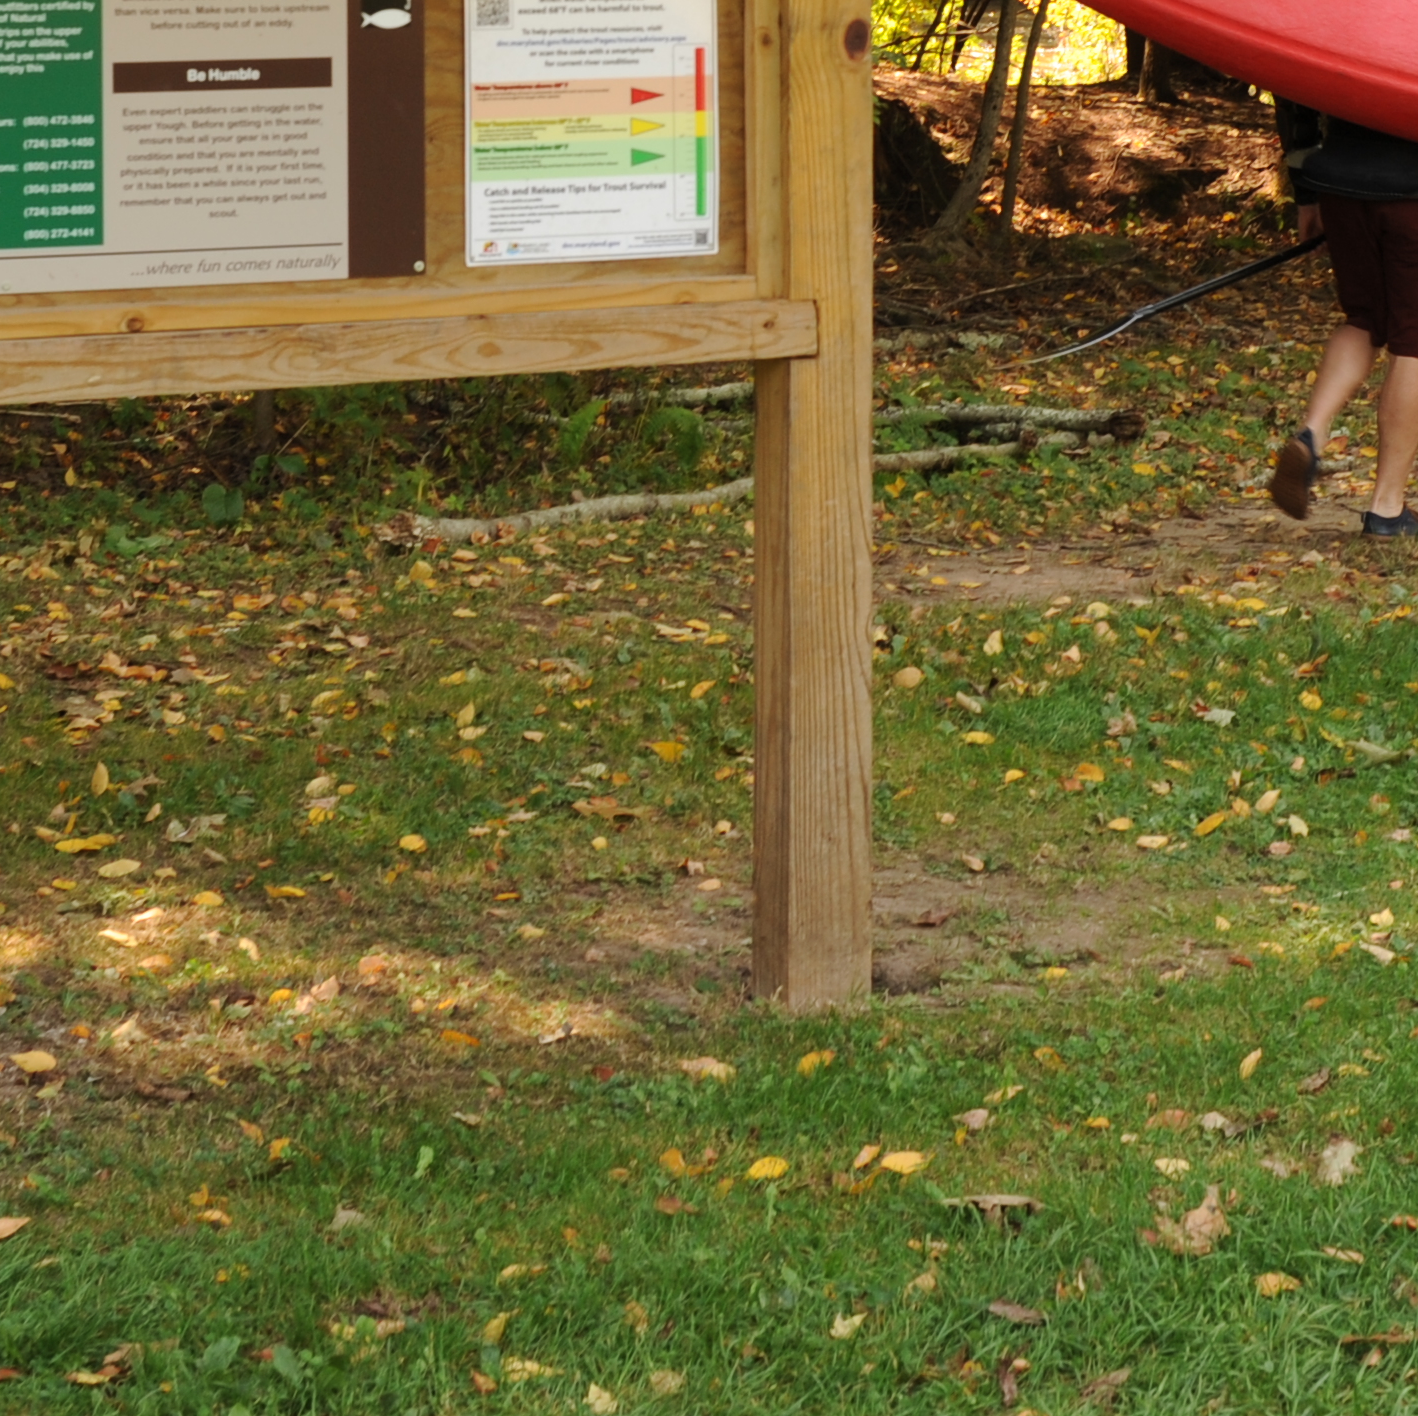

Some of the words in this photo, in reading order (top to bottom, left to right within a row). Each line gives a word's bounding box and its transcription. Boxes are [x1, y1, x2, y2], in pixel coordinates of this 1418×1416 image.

[186, 68, 206, 83] Be
[208, 67, 260, 82] Humble
[484, 188, 510, 197] Catch
[511, 187, 530, 196] and
[531, 186, 566, 195] Release
[568, 184, 586, 194] Tips
[588, 183, 603, 193] for
[603, 183, 627, 192] Trout
[629, 182, 667, 191] Survival
[130, 260, 193, 276] ...where
[197, 259, 221, 273] fun
[226, 260, 271, 272] comes
[275, 254, 341, 270] naturally
